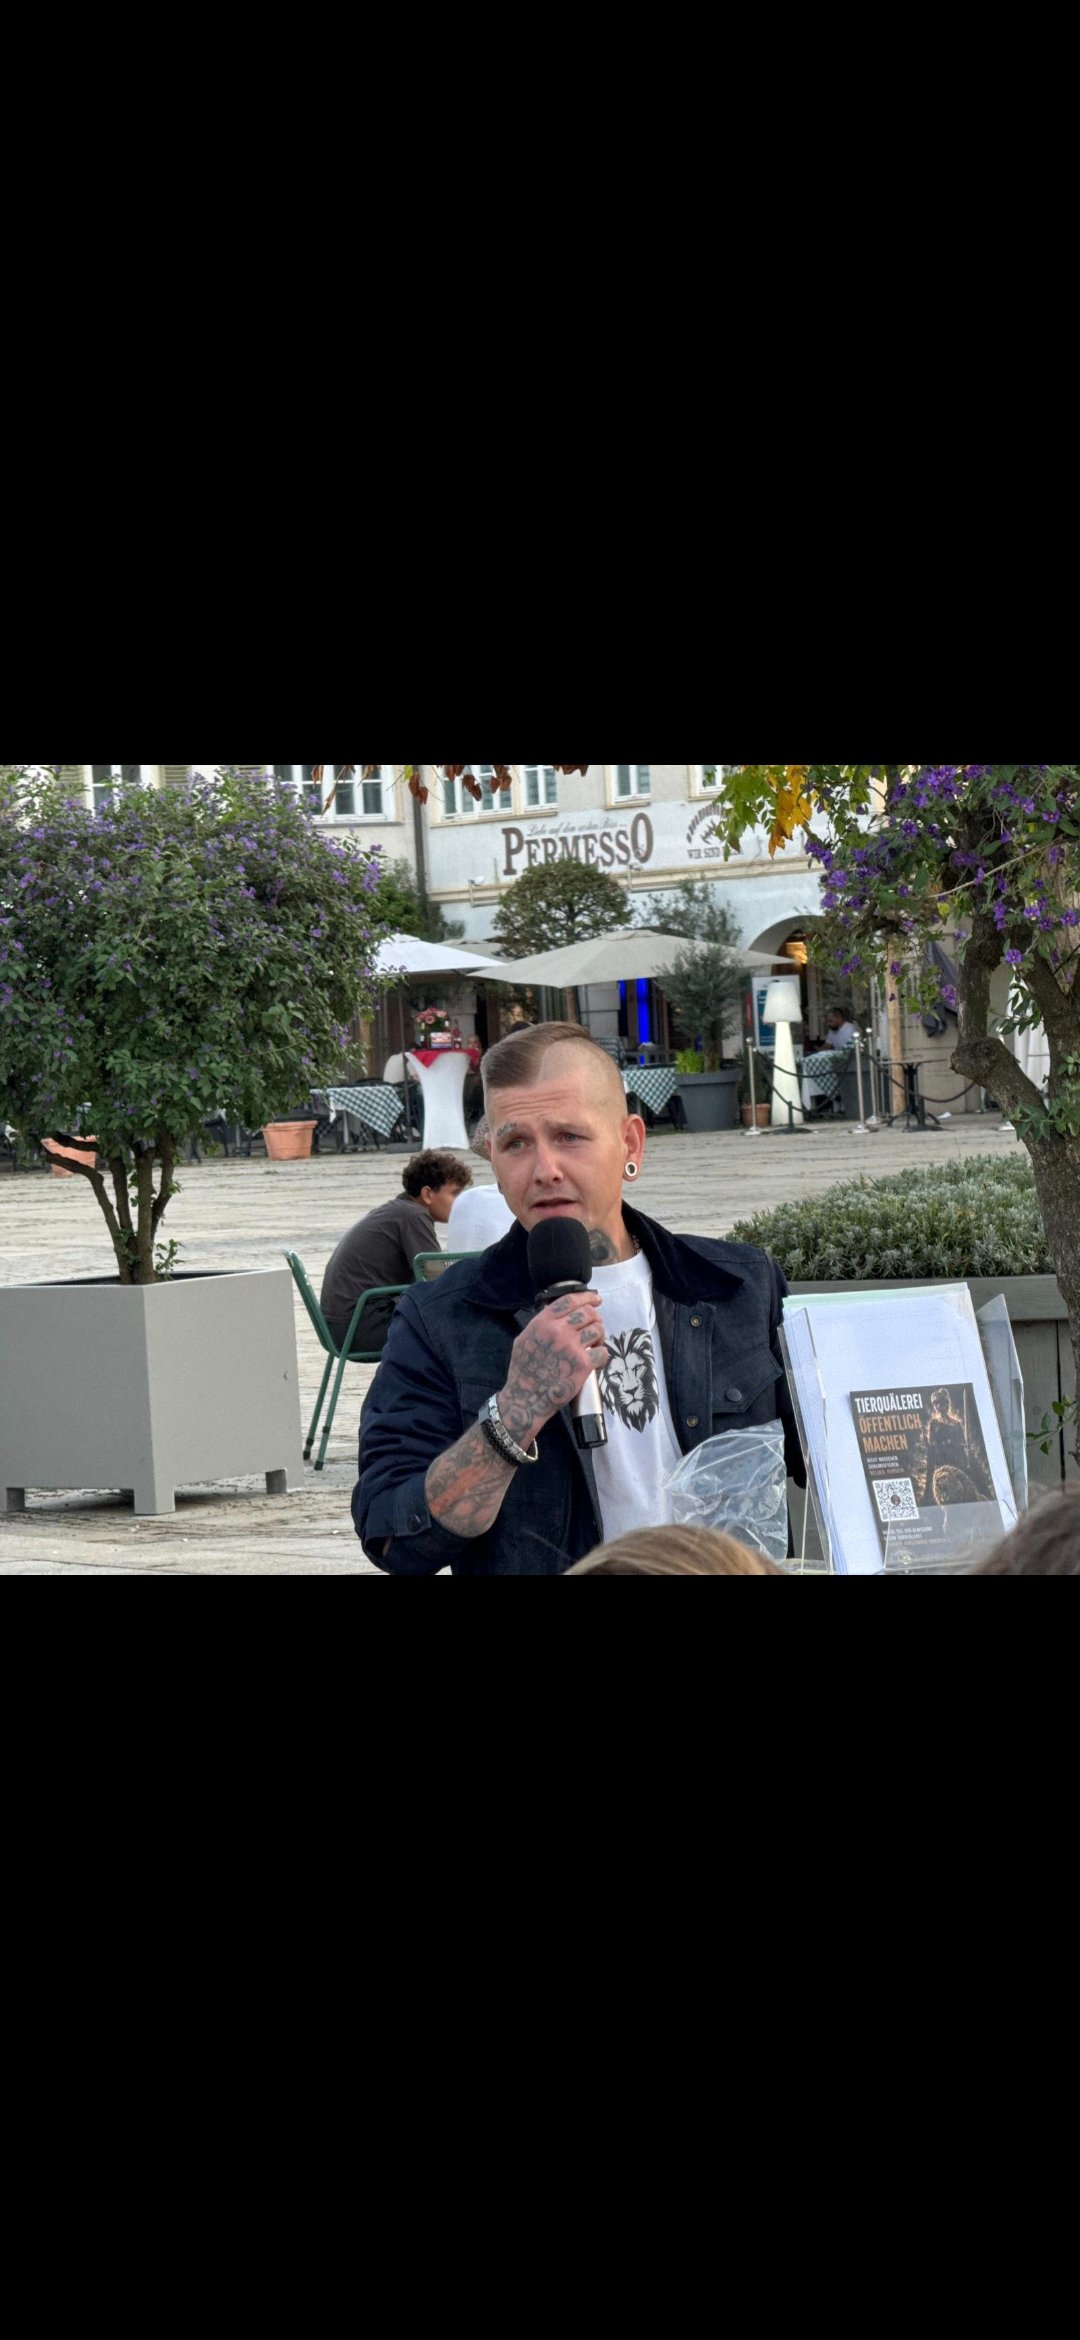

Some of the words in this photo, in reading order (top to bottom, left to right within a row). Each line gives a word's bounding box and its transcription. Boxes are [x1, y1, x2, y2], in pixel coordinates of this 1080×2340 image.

[501, 812, 654, 876] PERMESSO
[854, 1392, 923, 1414] TIERQUÄLEREI
[859, 1413, 922, 1434] ÖFFENTLICH
[862, 1433, 909, 1453] MACHEN
